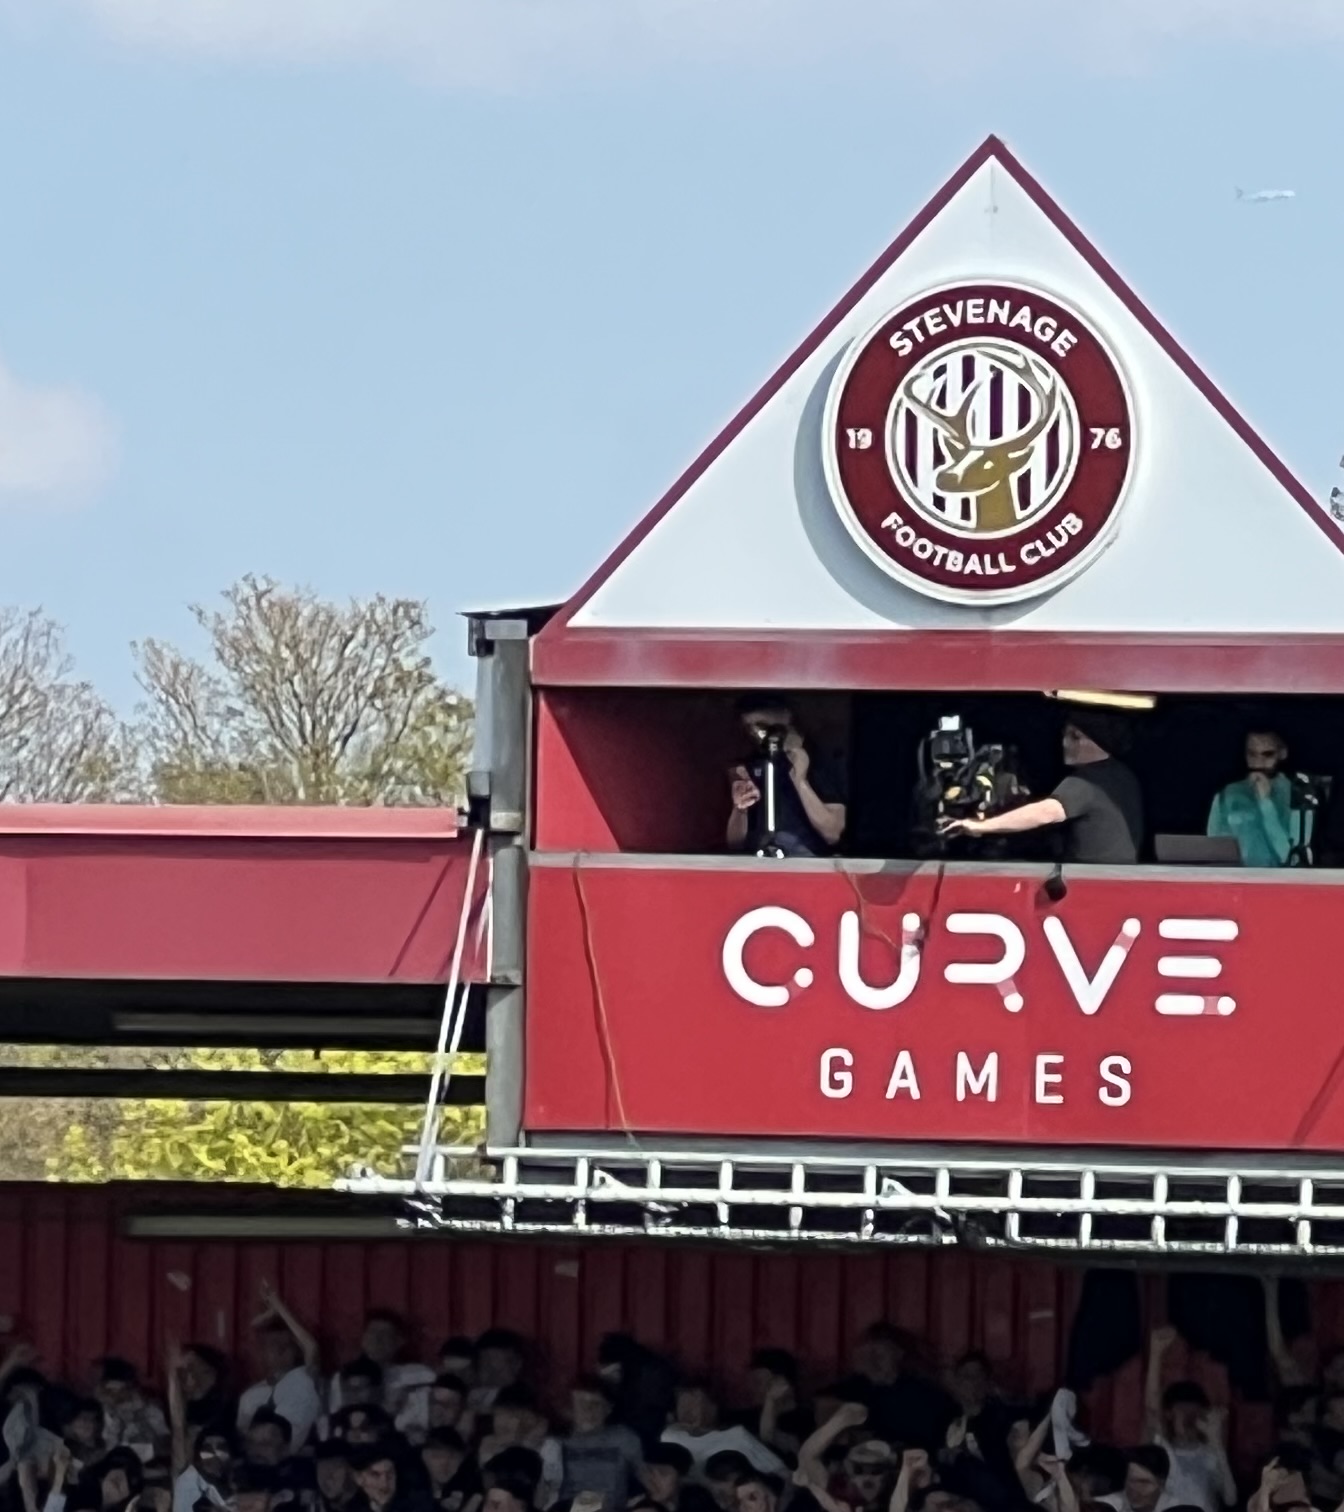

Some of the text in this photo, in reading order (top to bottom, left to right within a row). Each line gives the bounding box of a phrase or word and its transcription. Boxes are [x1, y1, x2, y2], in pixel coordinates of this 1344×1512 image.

[888, 298, 1078, 359] STEVENAGE
[846, 426, 874, 450] 19
[1089, 426, 1123, 451] 76
[879, 511, 1085, 577] FOOTBALL CLUB
[722, 904, 1240, 1016] CURVE
[819, 1047, 1133, 1107] GAMES
